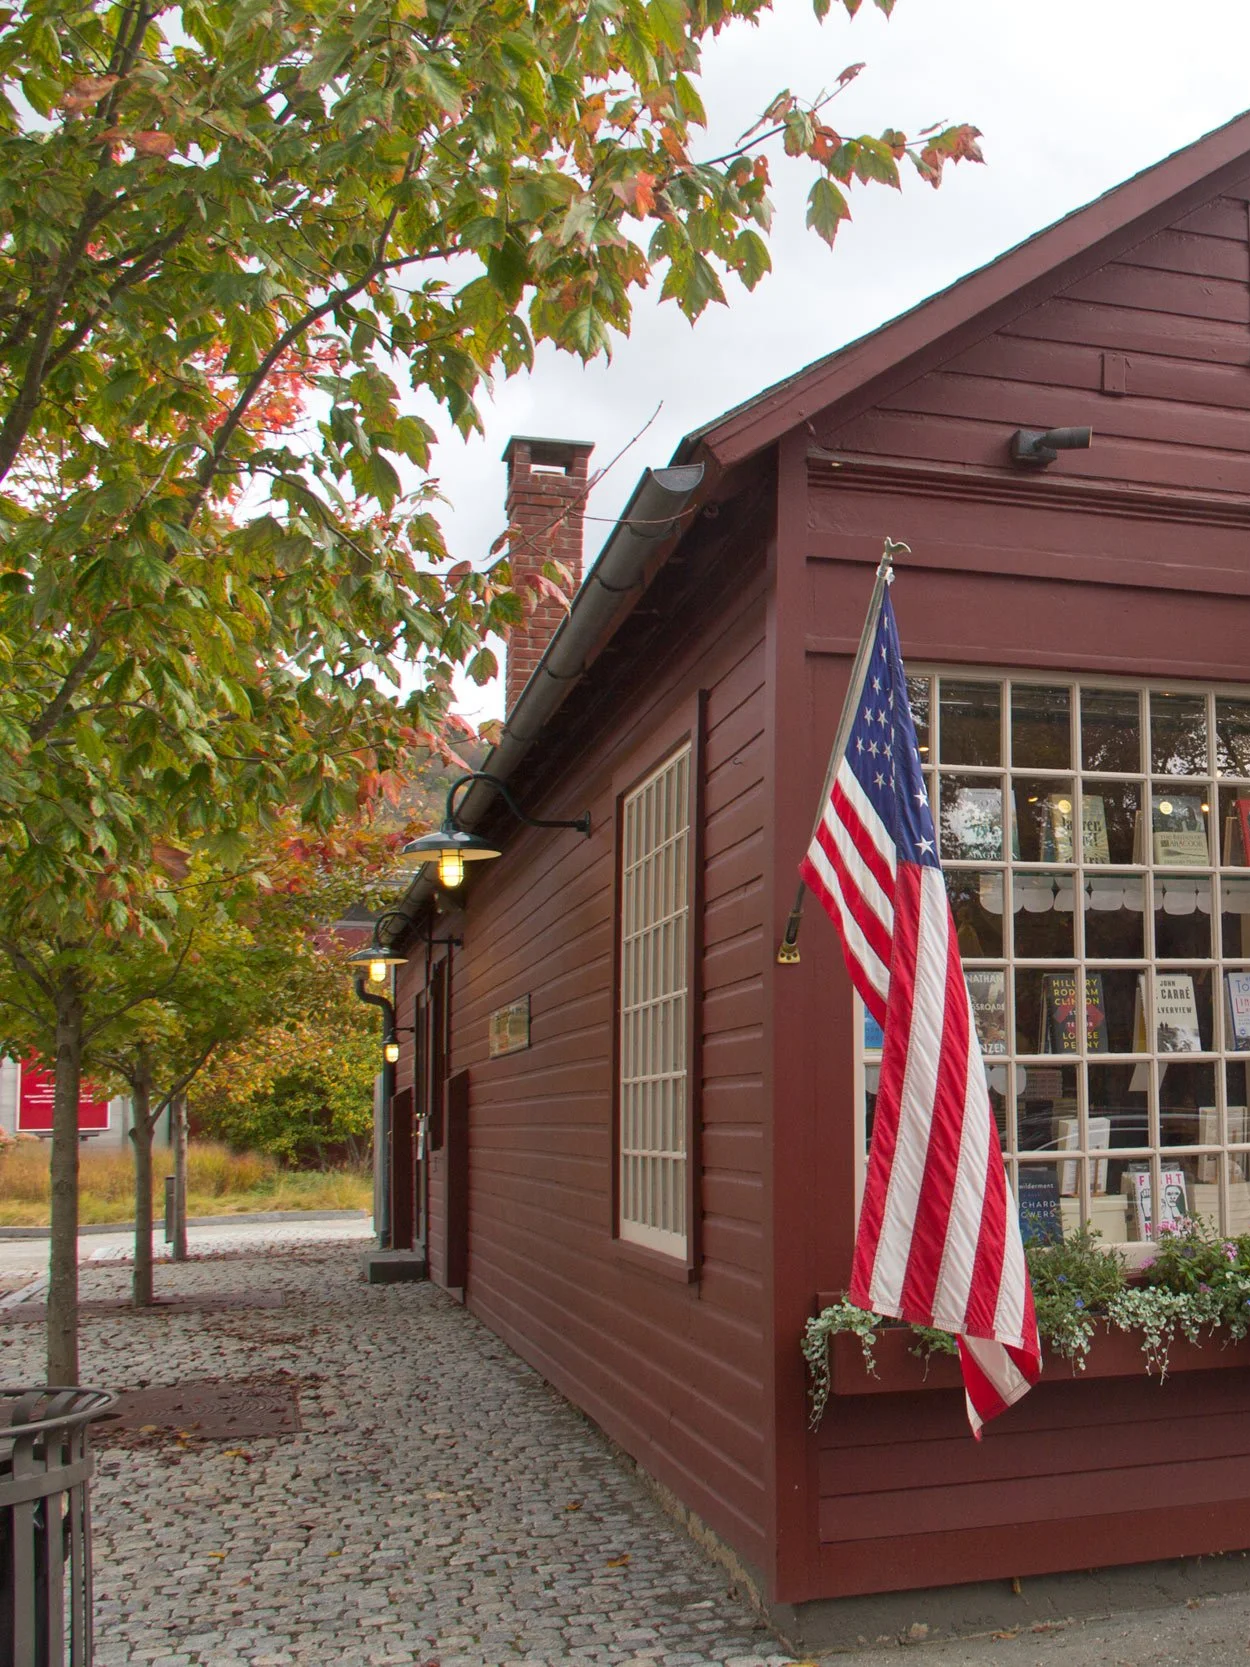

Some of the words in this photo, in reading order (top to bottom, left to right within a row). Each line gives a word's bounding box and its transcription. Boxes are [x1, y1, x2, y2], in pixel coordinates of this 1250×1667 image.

[966, 974, 1004, 984] NATHAN
[1052, 979, 1098, 988] HILLRY
[1053, 988, 1099, 997] RODAM
[1161, 986, 1191, 999] CARRÉ
[1054, 998, 1100, 1006] CLINON
[1157, 1006, 1192, 1014] LVERVIEW
[1062, 1031, 1100, 1040] LOSE
[1063, 1041, 1099, 1049] PENY
[1021, 1200, 1057, 1209] CHARD
[1020, 1210, 1056, 1219] OWERS
